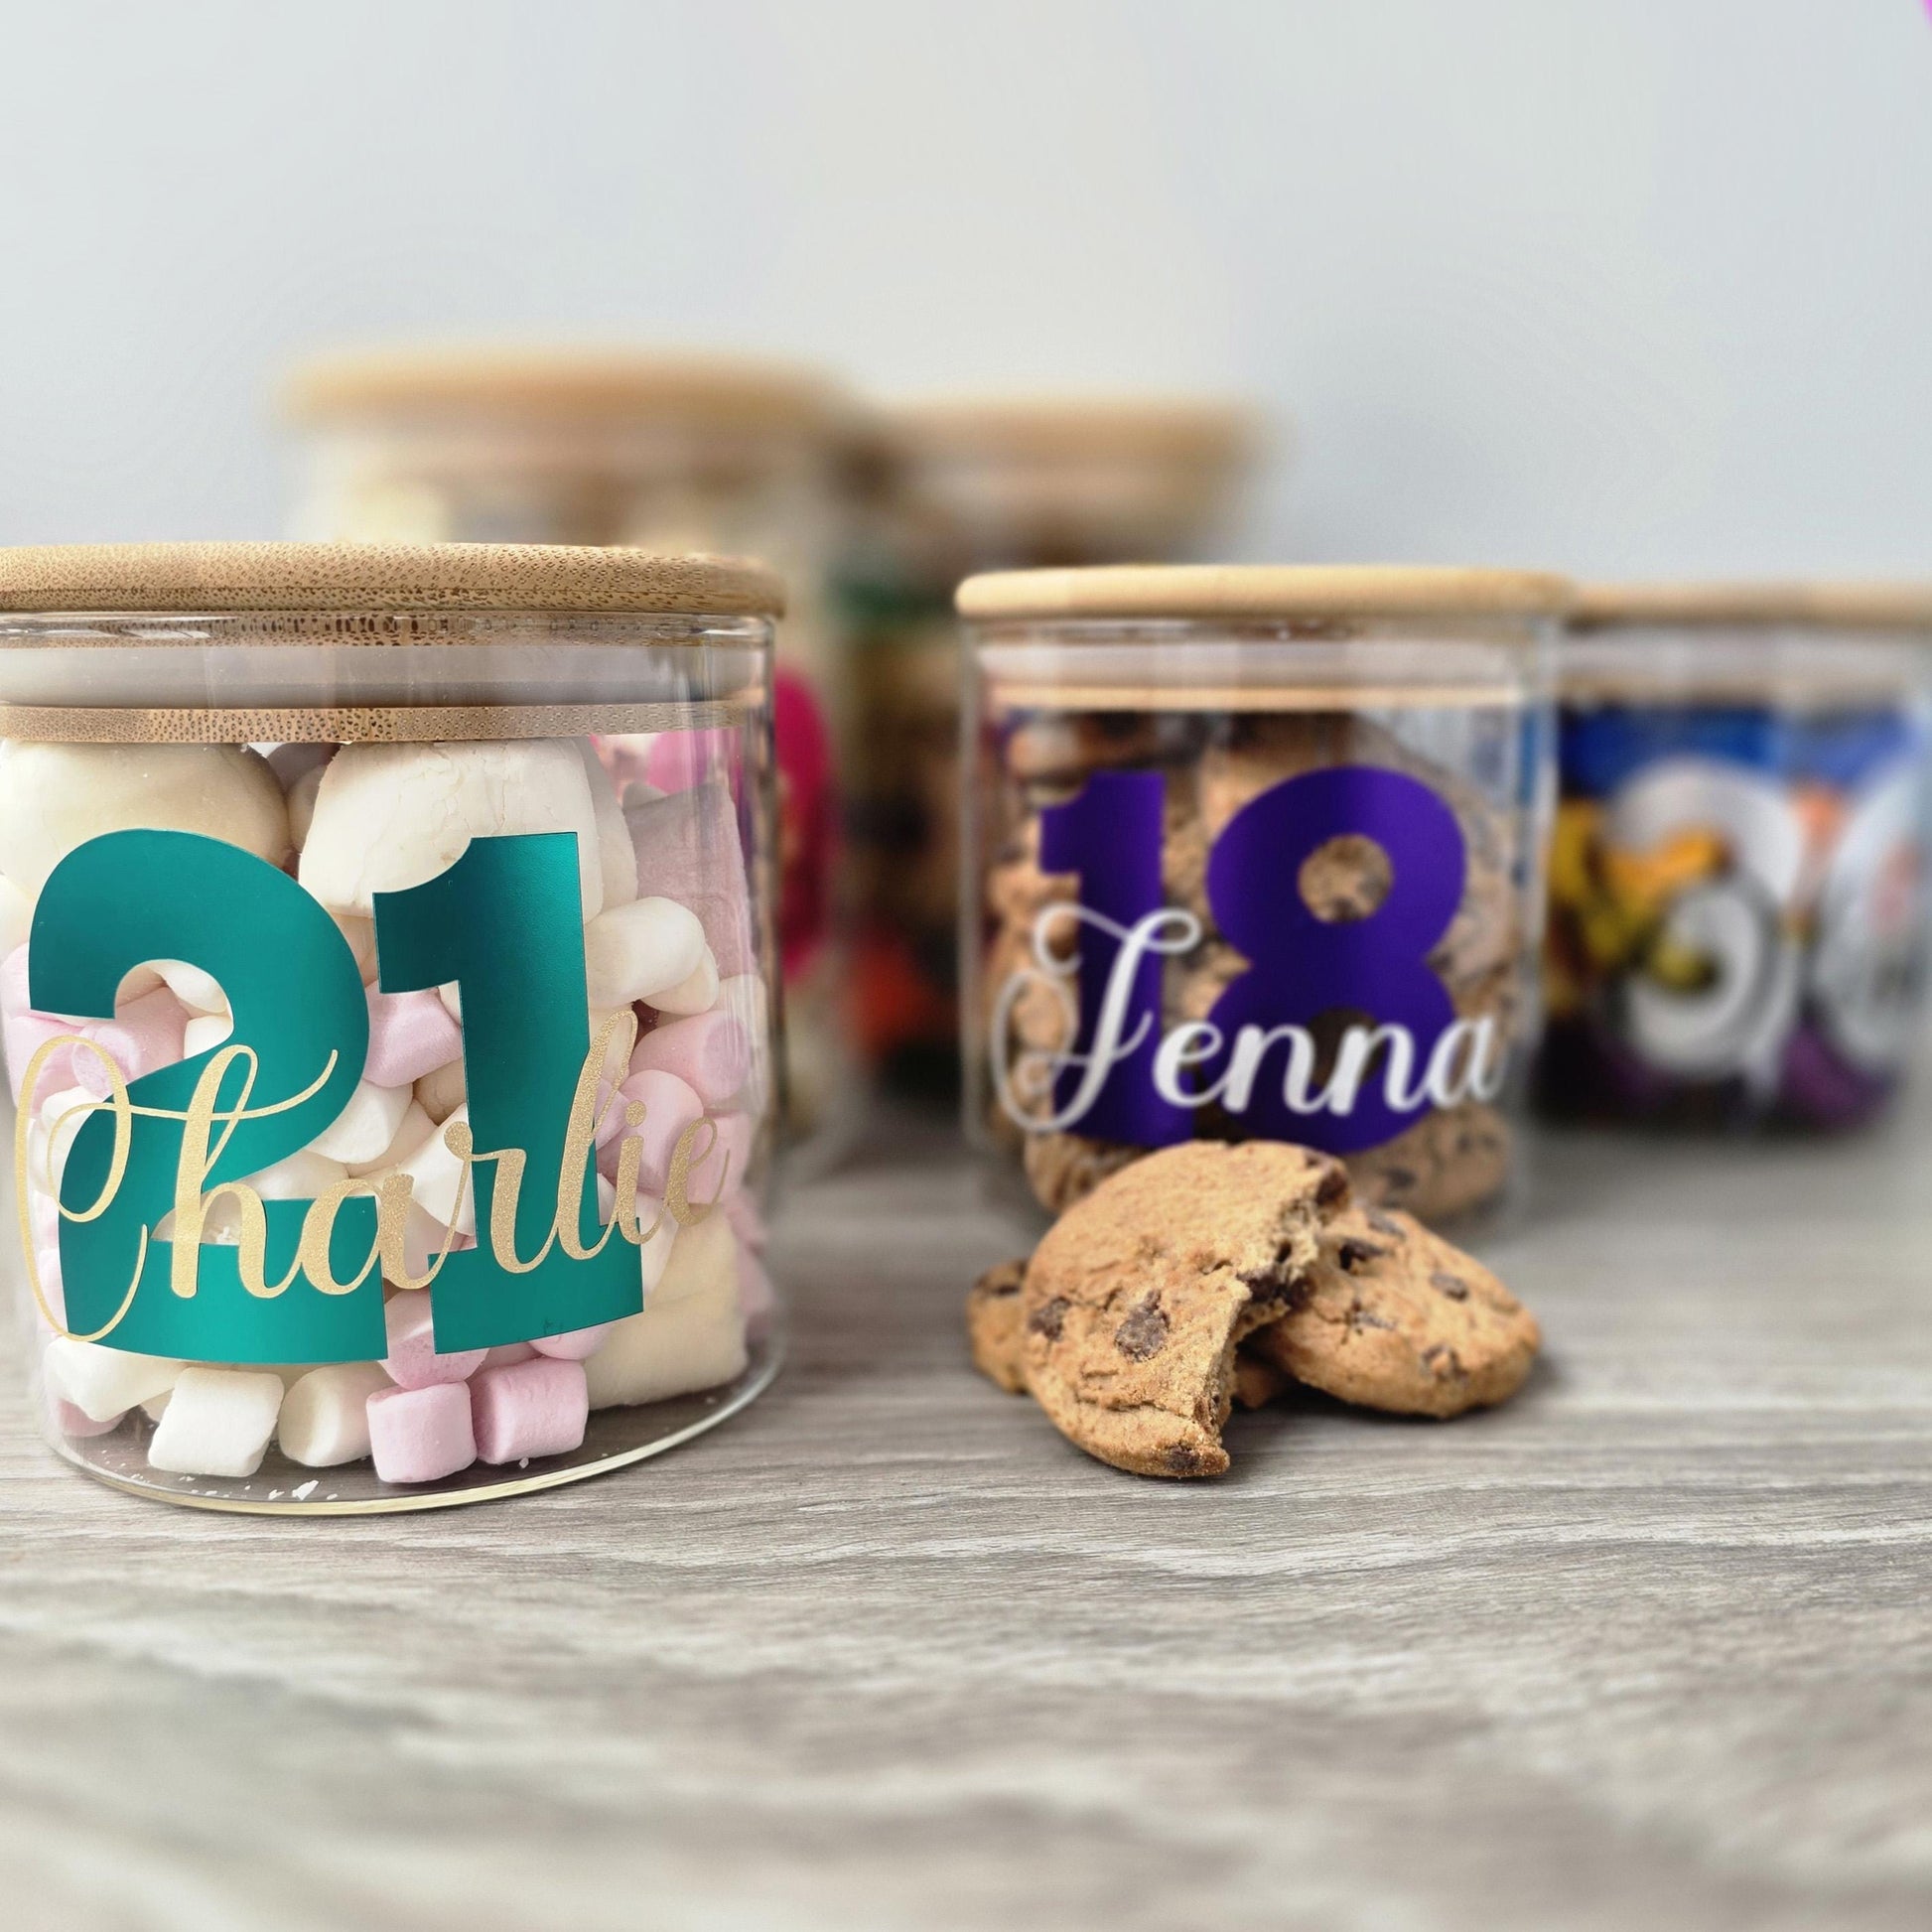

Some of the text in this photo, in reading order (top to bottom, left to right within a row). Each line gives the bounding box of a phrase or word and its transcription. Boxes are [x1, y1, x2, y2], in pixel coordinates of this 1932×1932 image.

[29, 828, 644, 1364] 21
[1038, 763, 1468, 1156] 18
[14, 1009, 731, 1342] Charlie
